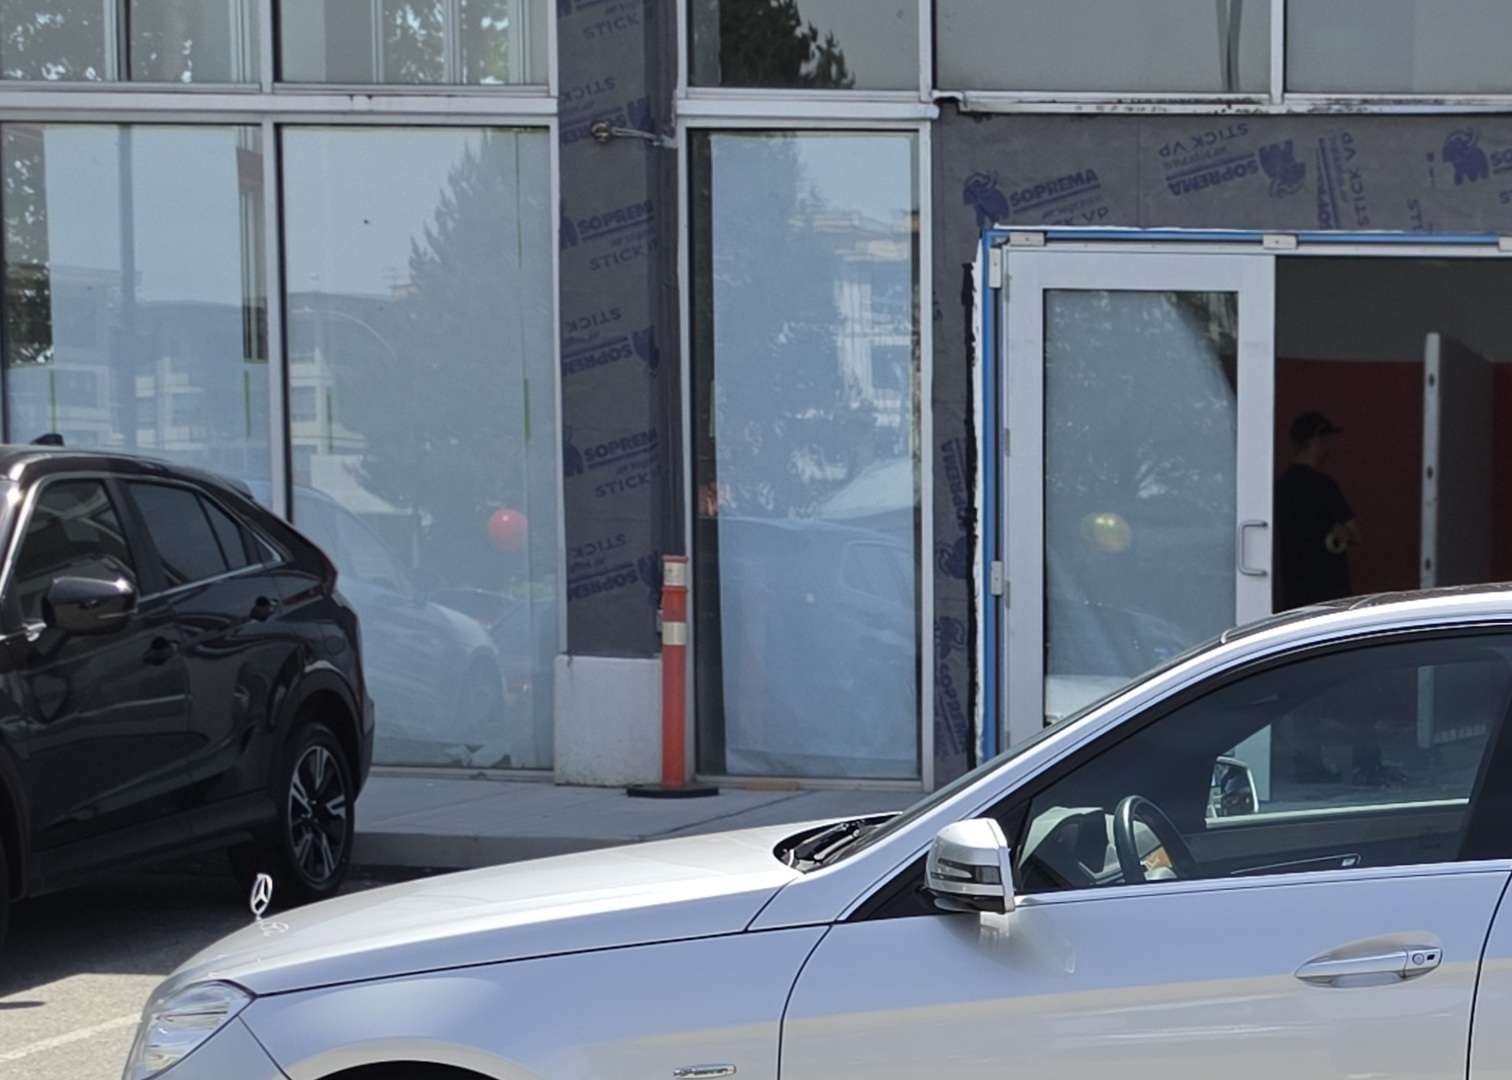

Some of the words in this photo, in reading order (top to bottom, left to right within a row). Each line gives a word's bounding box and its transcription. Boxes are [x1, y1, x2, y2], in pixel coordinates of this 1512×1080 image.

[1191, 122, 1249, 148] STICK
[1341, 131, 1358, 162] VP
[1159, 141, 1186, 158] VP
[1010, 169, 1099, 208] SOPREMA
[1167, 159, 1259, 196] SOPREMA
[1348, 168, 1370, 226] STICK
[566, 307, 622, 332] STICK
[594, 471, 650, 497] STICK
[573, 533, 626, 558] STICK
